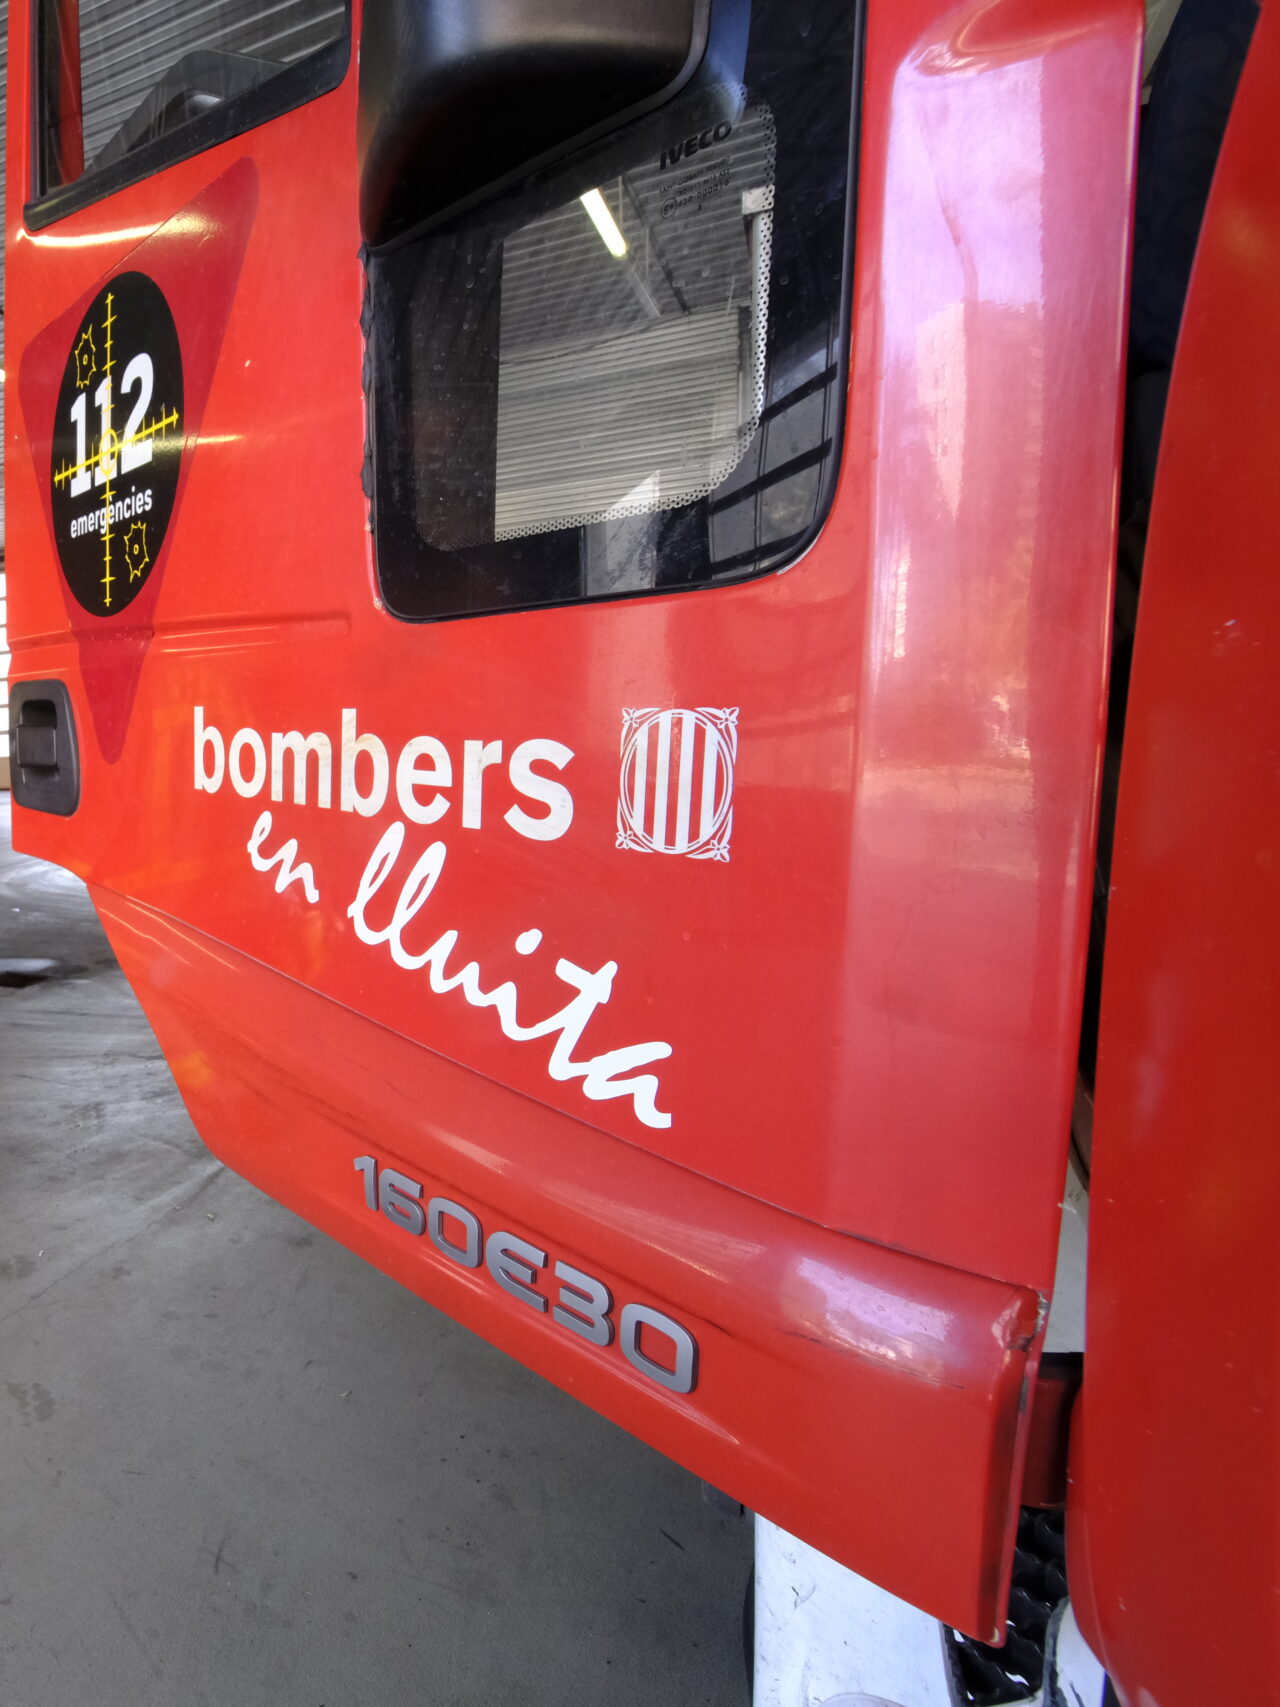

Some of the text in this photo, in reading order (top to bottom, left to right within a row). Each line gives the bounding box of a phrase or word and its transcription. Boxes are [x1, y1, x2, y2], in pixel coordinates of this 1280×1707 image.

[660, 120, 732, 170] IVECO
[70, 352, 154, 499] 112
[70, 486, 153, 539] emergències
[193, 705, 575, 842] bombers
[247, 810, 673, 1129] en lluita
[353, 1155, 699, 1394] 160E30
